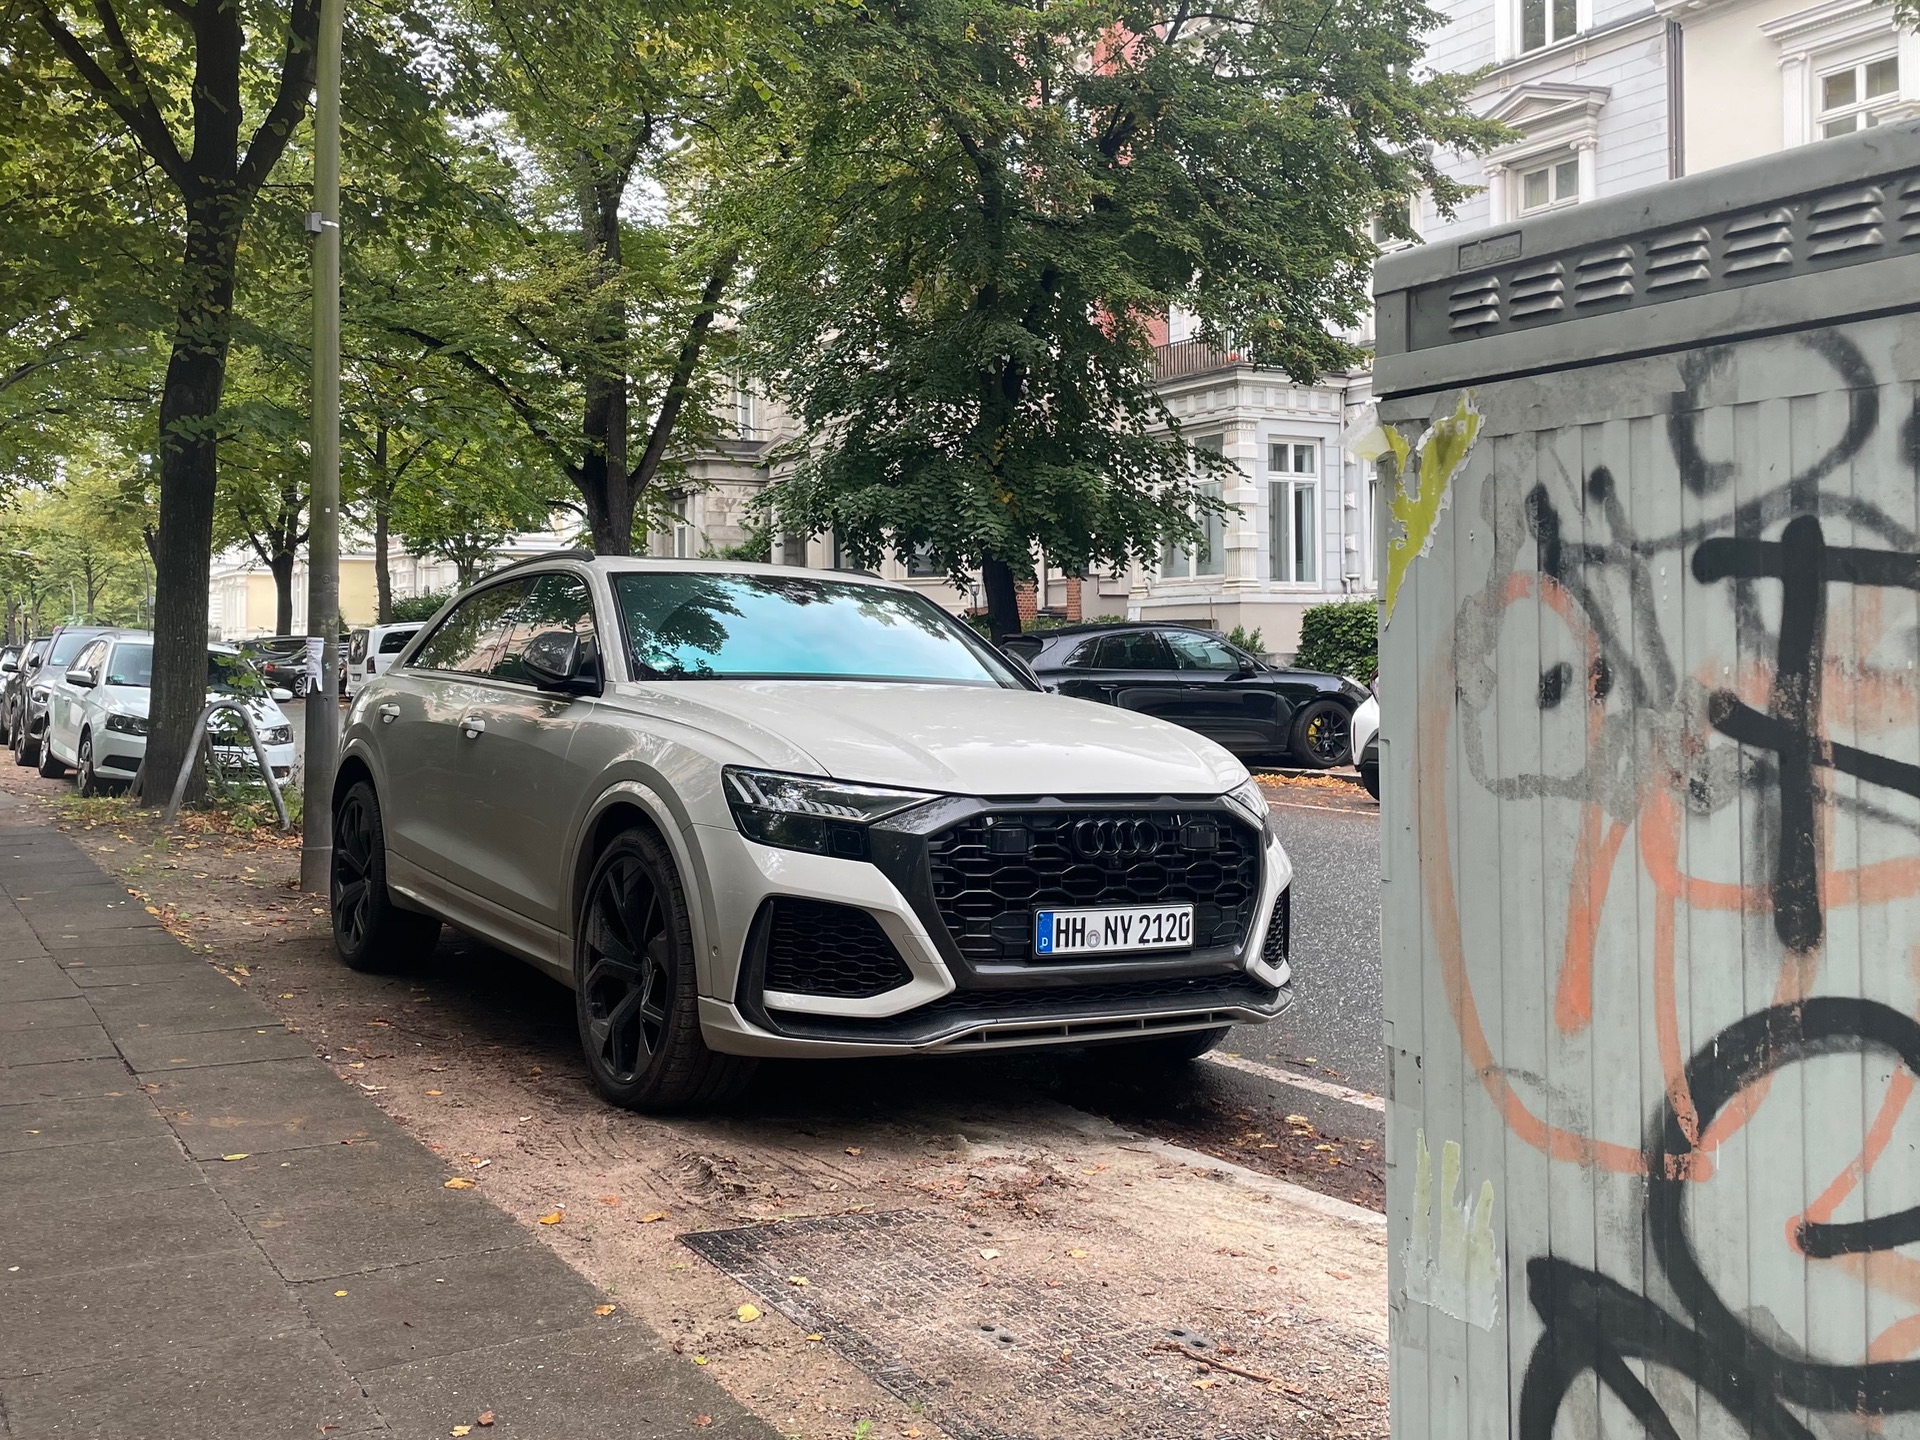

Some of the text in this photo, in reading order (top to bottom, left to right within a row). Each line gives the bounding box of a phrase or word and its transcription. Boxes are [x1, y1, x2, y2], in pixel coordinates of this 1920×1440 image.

[1055, 912, 1190, 948] HH NY 2120
[1042, 937, 1048, 946] D
